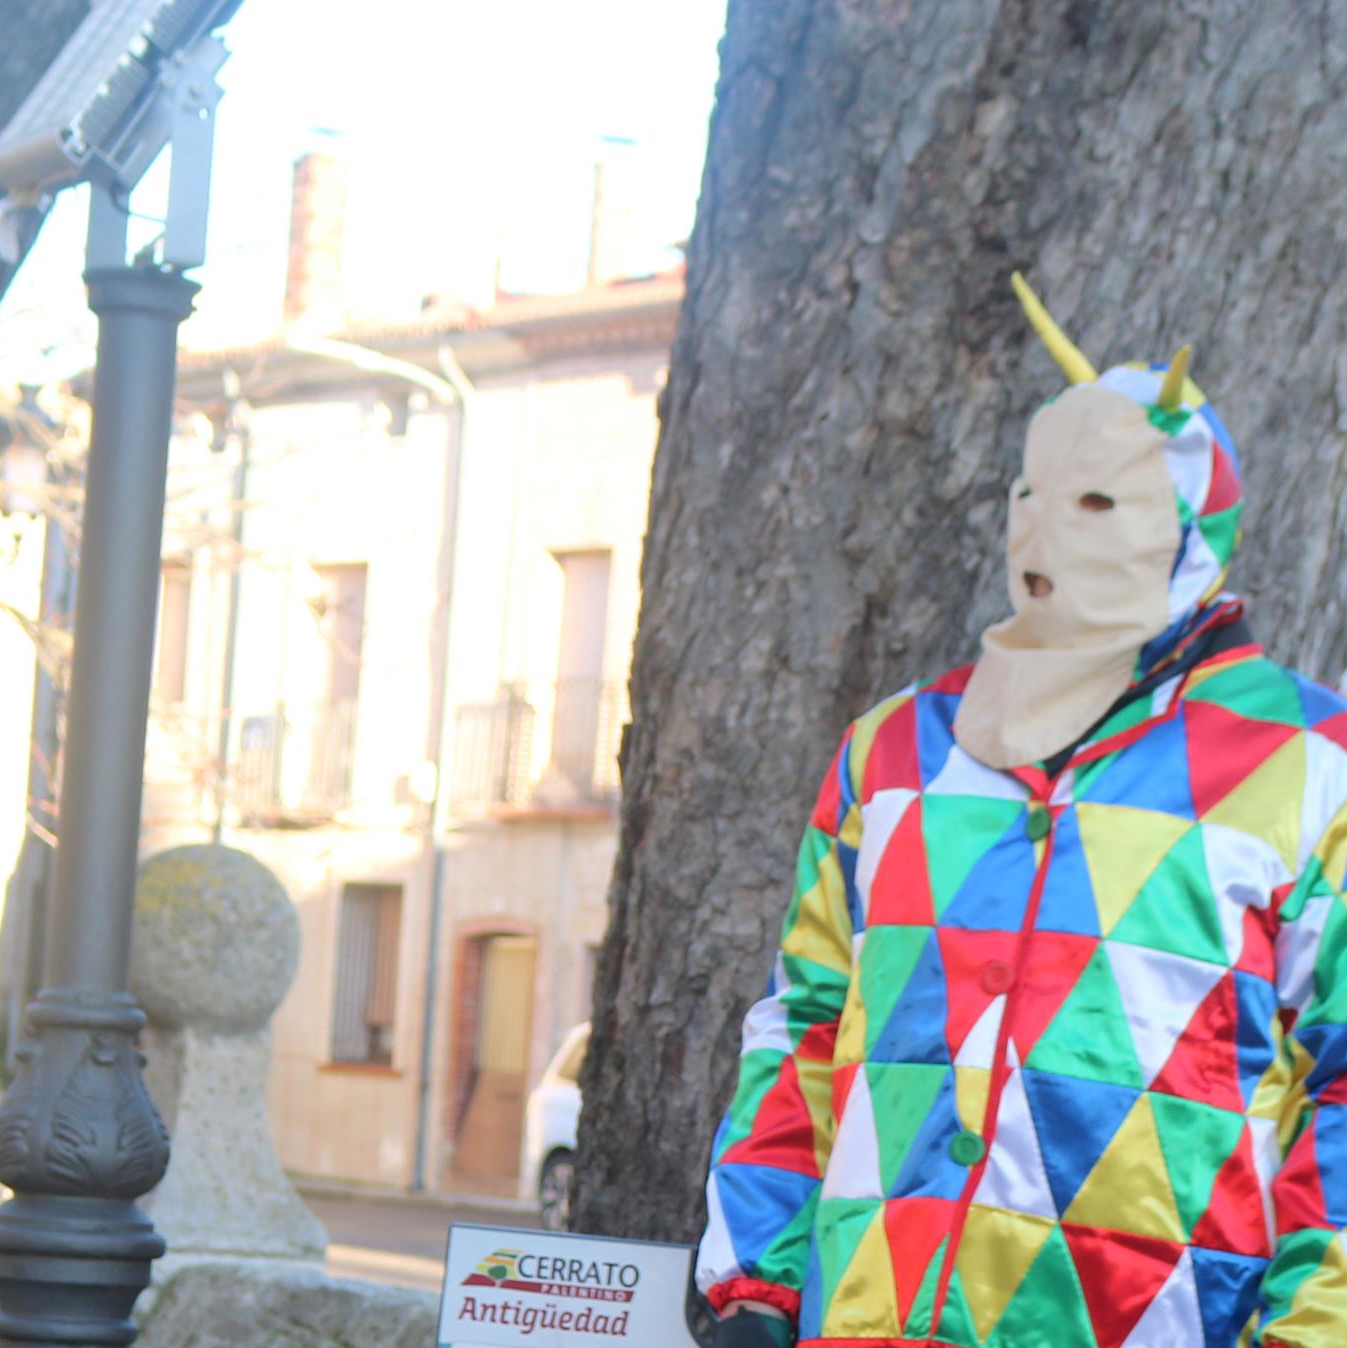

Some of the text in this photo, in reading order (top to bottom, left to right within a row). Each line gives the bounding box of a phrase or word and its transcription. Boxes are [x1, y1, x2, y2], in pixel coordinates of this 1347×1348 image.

[518, 1254, 640, 1288] CERRATO
[540, 1283, 626, 1301] PALENTINO
[458, 1296, 631, 1336] Antigüedad
